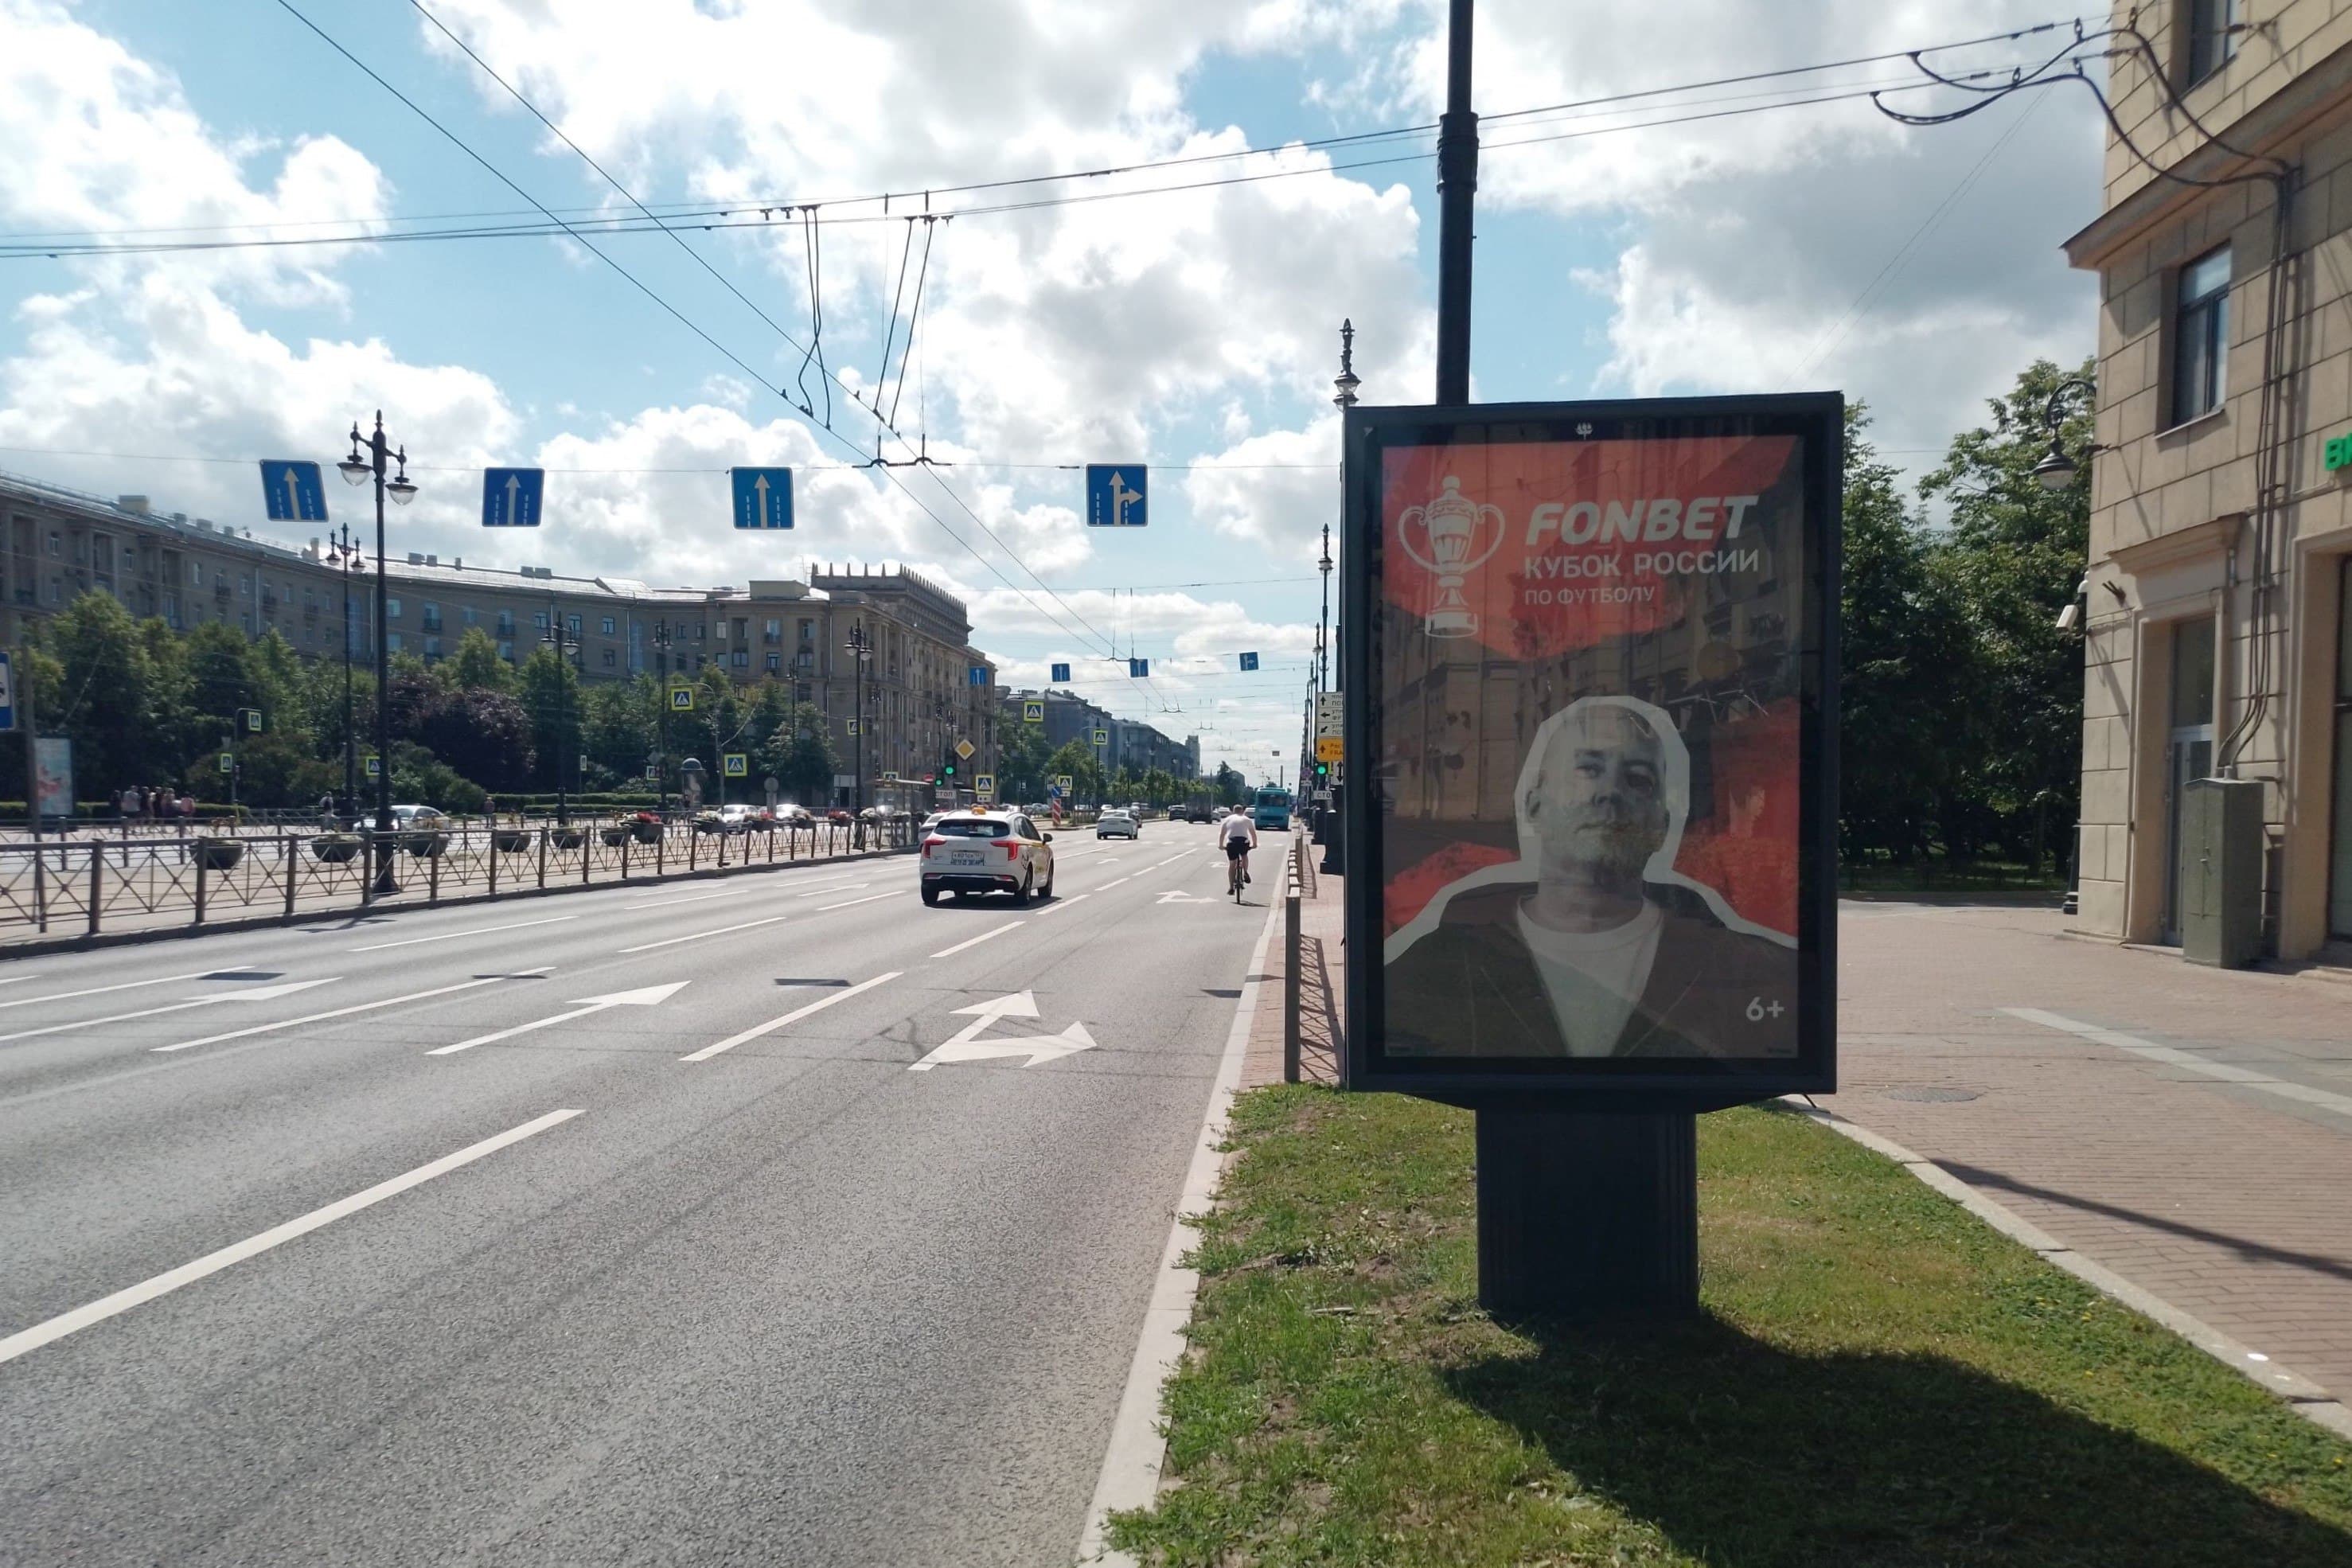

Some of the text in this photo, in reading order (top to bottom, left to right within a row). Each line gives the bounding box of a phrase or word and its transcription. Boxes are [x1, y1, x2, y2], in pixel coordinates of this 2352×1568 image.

[1525, 495, 1758, 545] FONBET
[1525, 549, 1759, 580] КУБОК РОССИИ
[1525, 587, 1656, 605] ПО ФУТБОЛУ
[1745, 997, 1784, 1021] 6+
